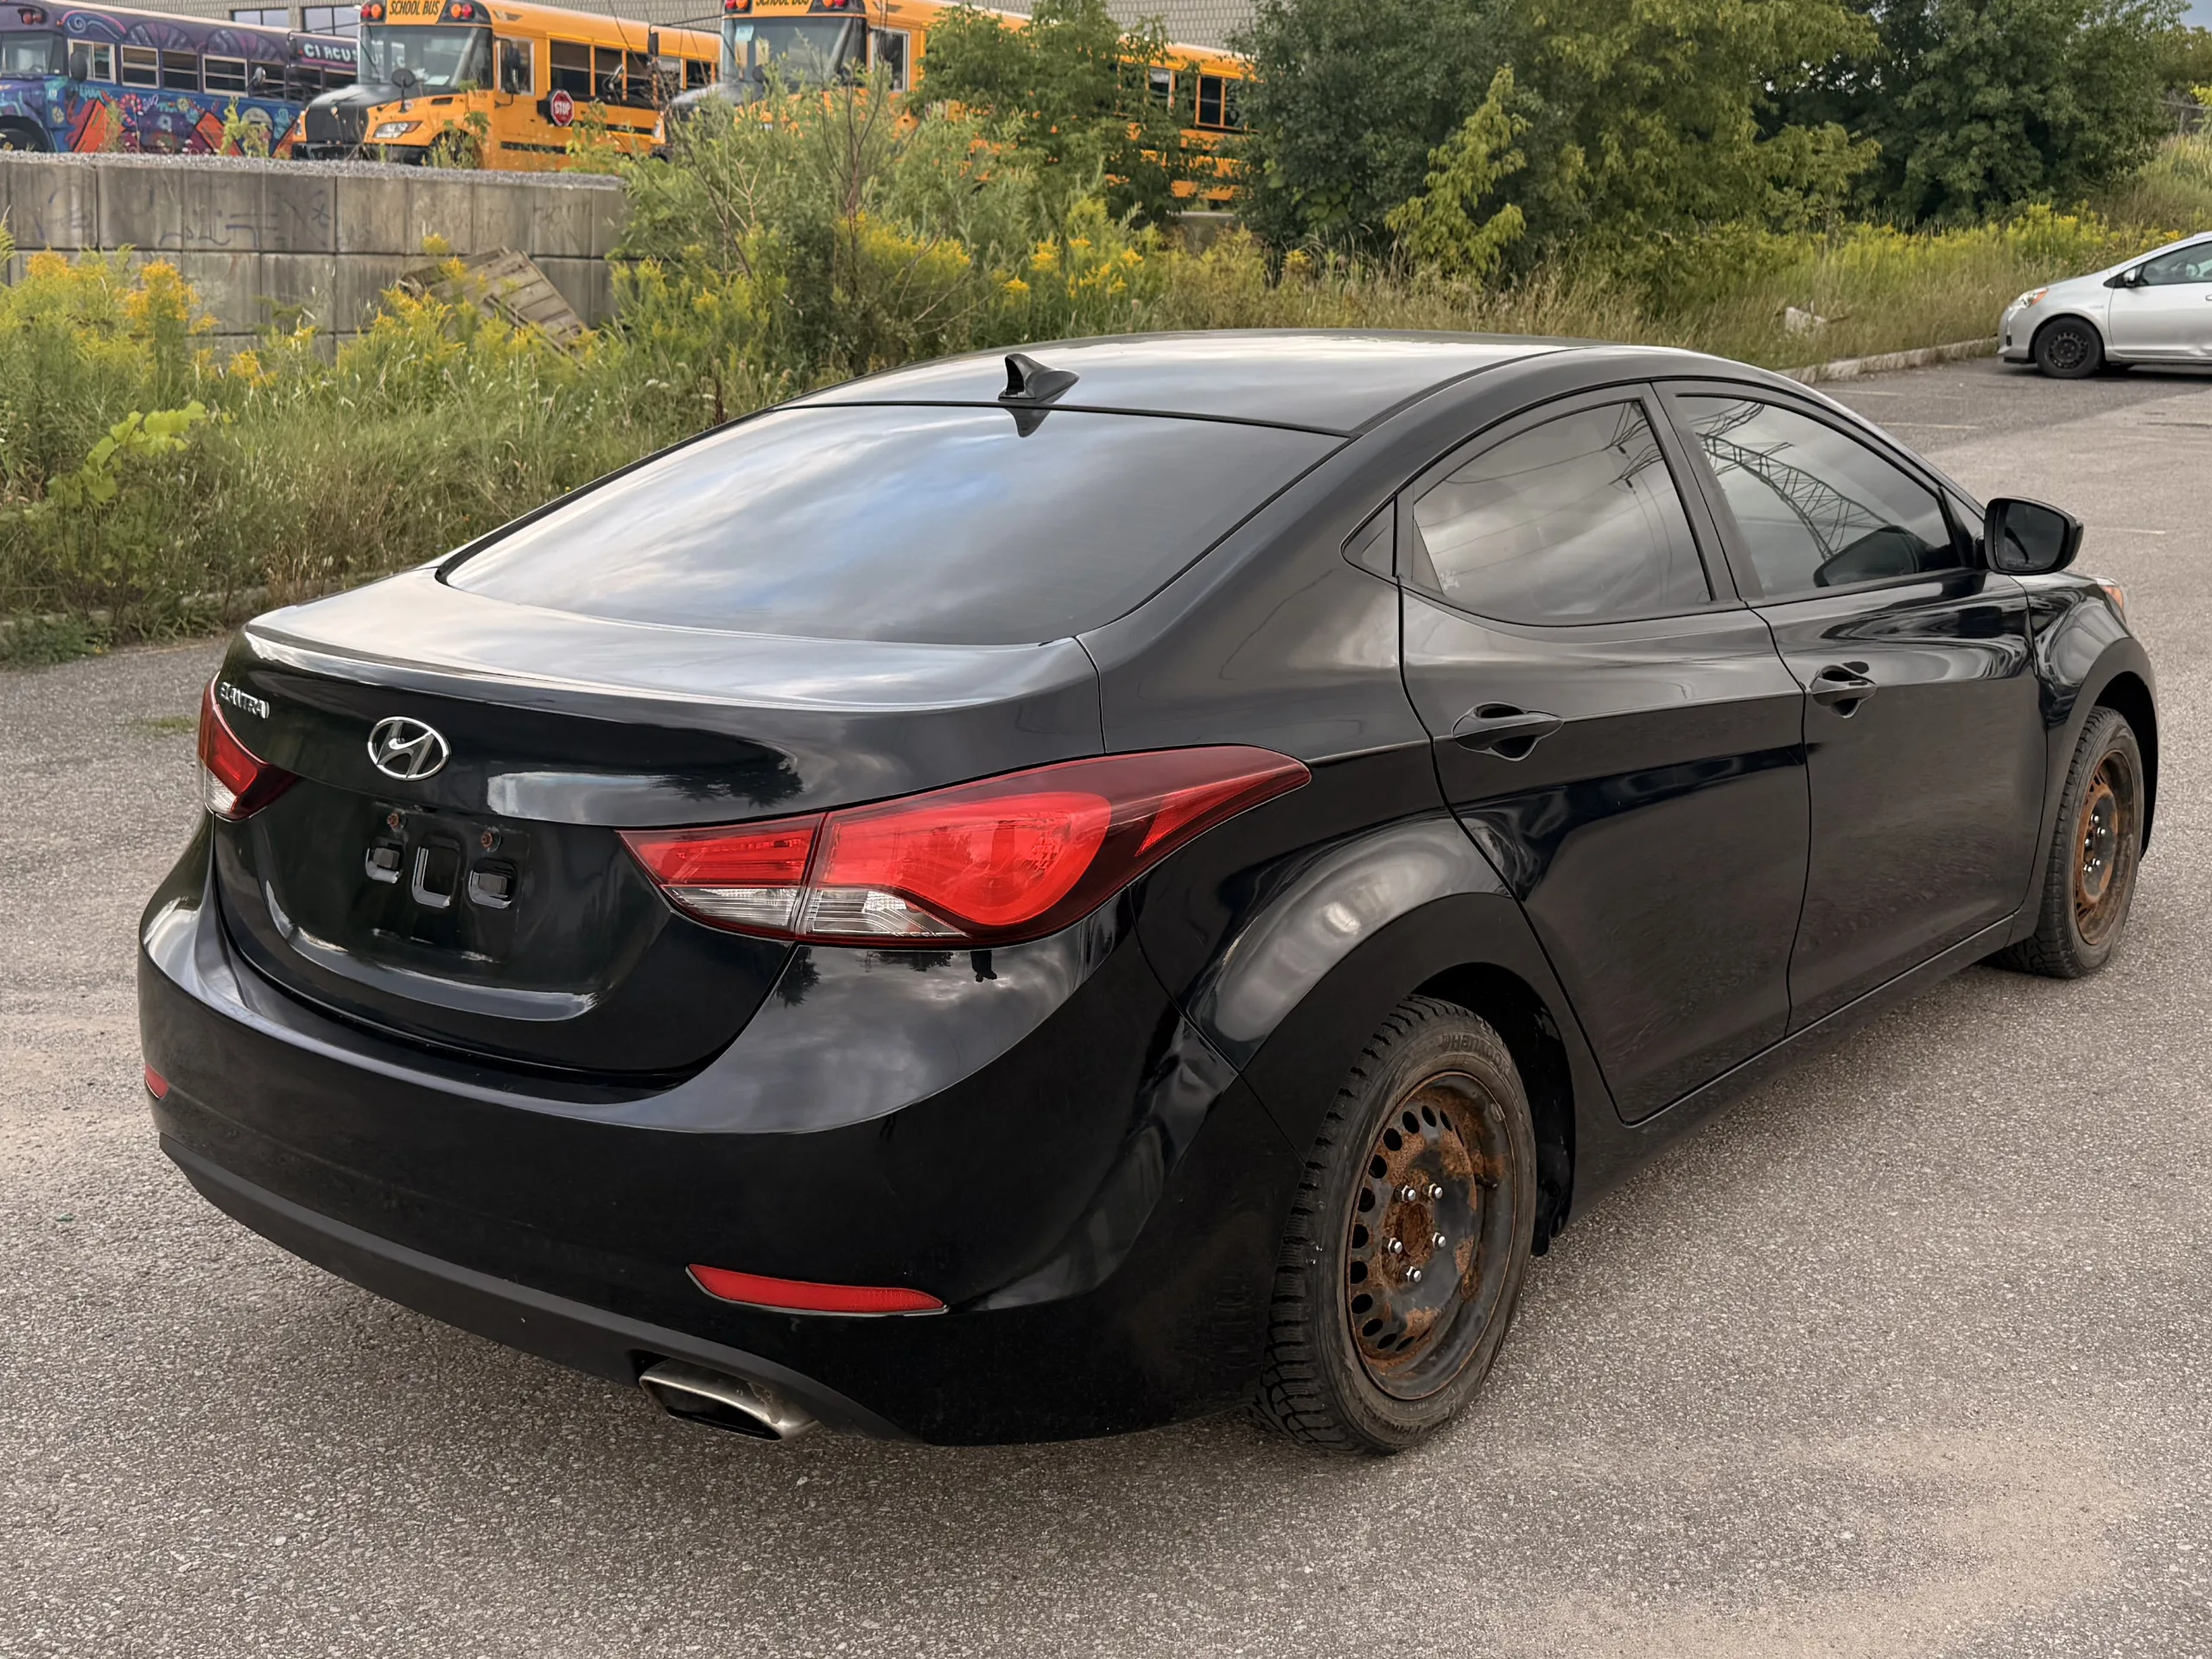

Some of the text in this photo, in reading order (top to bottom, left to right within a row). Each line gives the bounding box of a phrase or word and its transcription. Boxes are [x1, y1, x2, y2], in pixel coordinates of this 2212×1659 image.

[389, 0, 441, 16] SCHOOL BUS
[554, 100, 571, 116] STOP
[220, 681, 270, 719] ELANTRA
